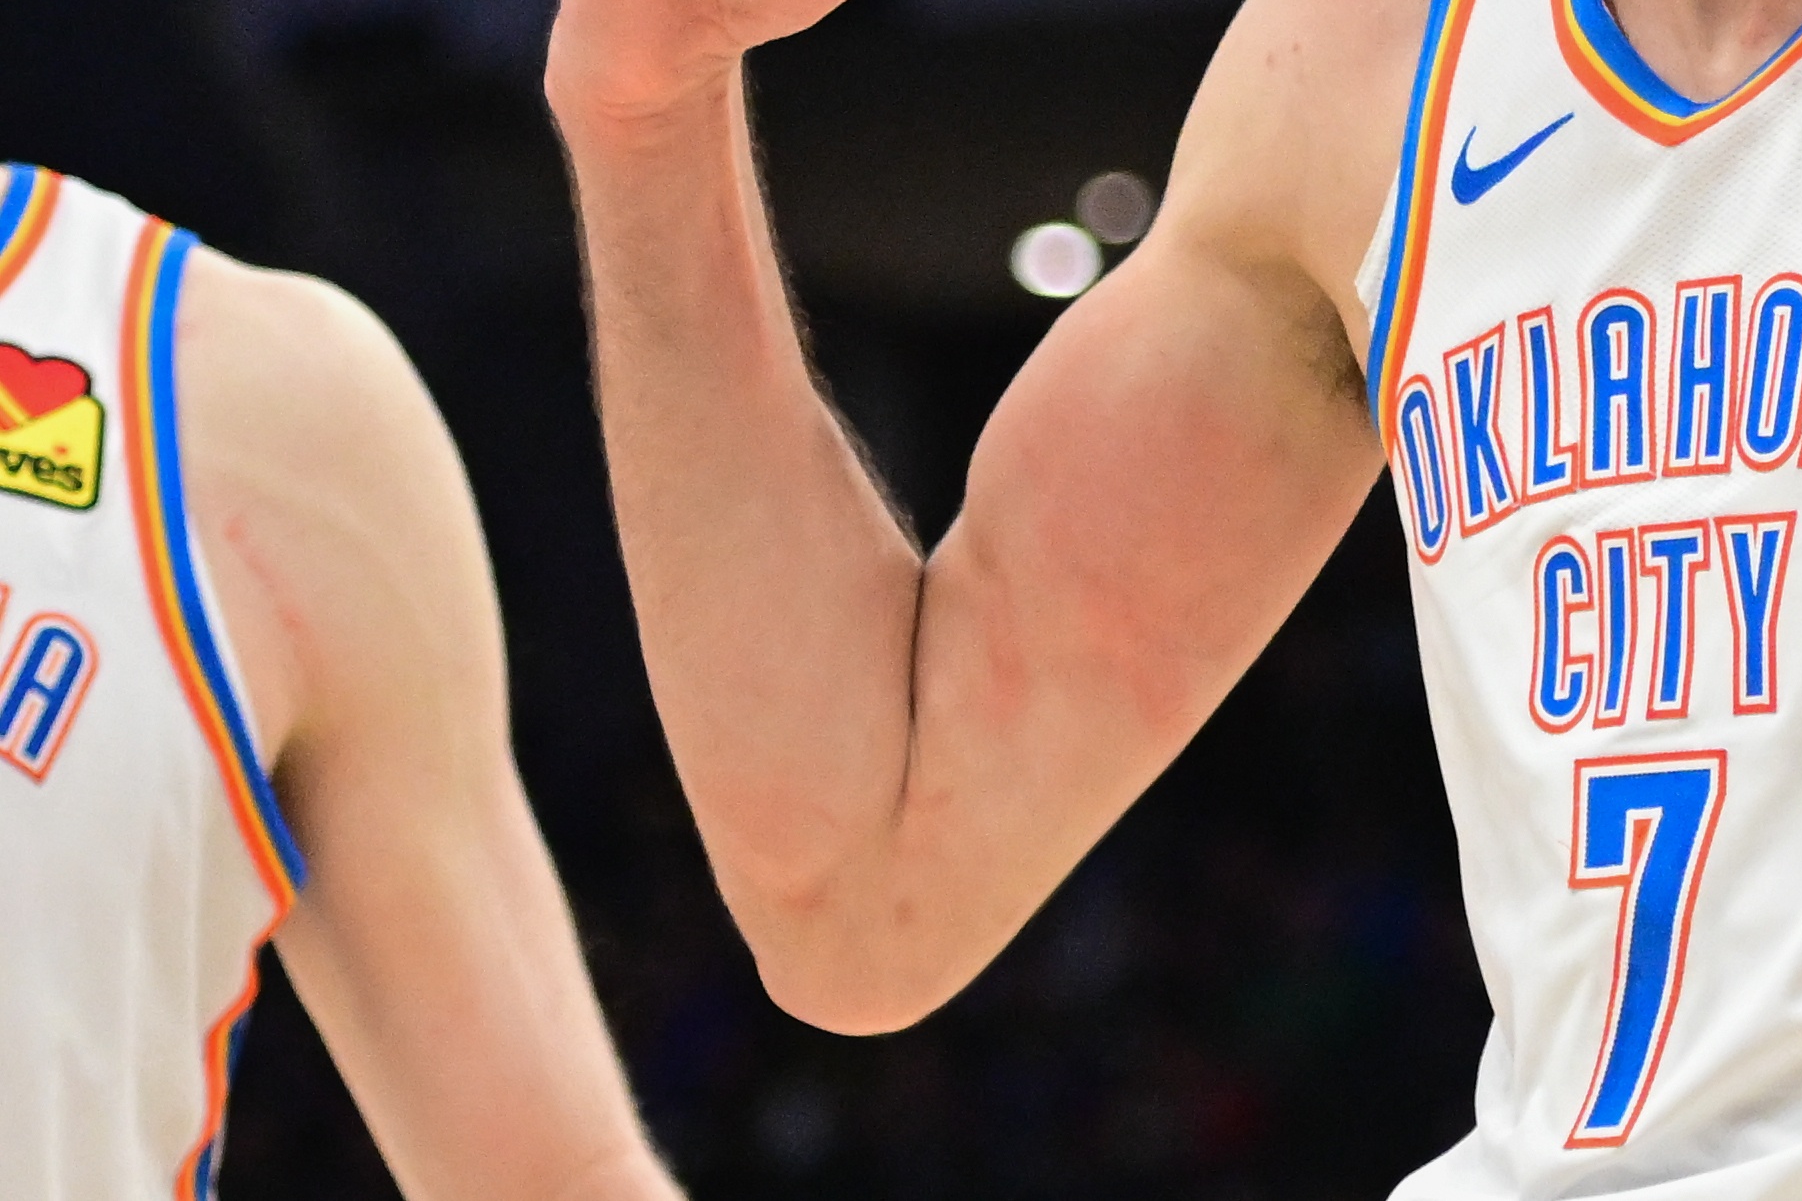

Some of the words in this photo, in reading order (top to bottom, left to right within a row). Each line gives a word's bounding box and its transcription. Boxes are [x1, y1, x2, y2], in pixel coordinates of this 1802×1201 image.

[0, 448, 83, 492] ves
[0, 580, 98, 785] A
[1529, 510, 1798, 735] CITY
[1563, 748, 1728, 1150] 7
